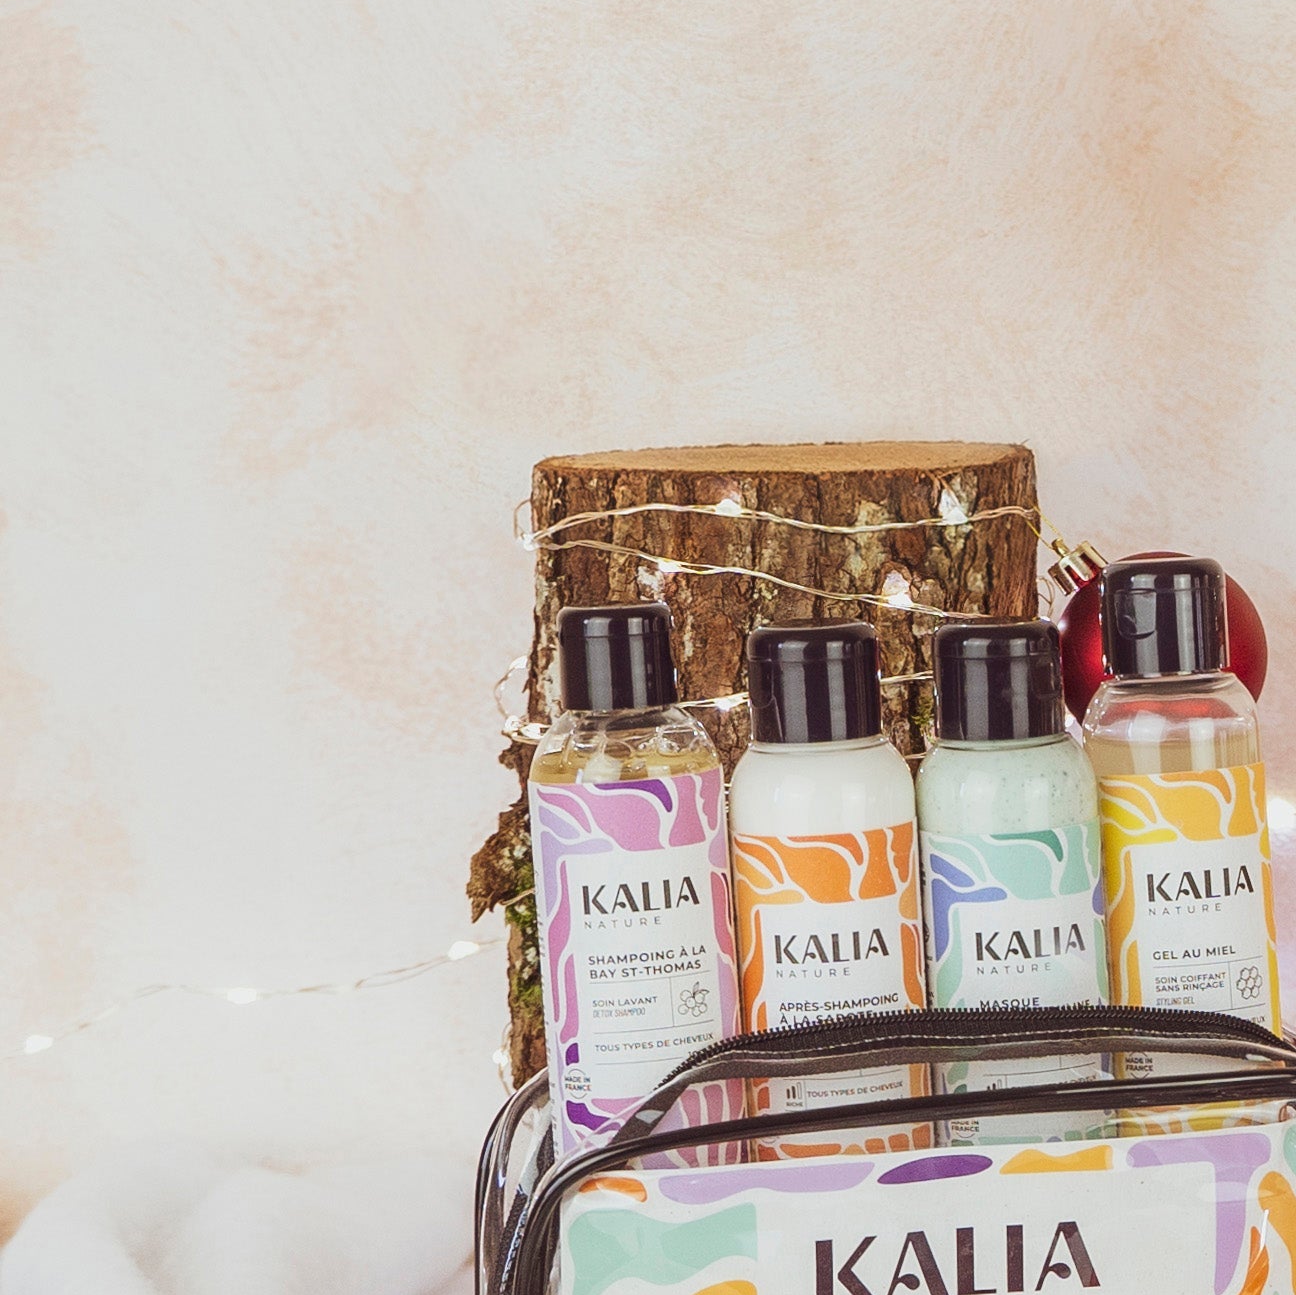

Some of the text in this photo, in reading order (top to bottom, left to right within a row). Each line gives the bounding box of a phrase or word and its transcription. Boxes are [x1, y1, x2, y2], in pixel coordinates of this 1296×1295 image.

[1147, 865, 1254, 902] KALIA
[582, 877, 700, 914] KALIA
[1149, 903, 1222, 915] NATURE
[584, 916, 662, 929] NATURE
[774, 929, 889, 964] KALIA
[975, 923, 1085, 961] KALIA
[588, 945, 706, 965] SHAMPOING À LA
[1153, 946, 1235, 960] GEL AU MIEL
[590, 960, 701, 979] BAY ST-THOMAS
[776, 967, 851, 978] NATURE
[977, 962, 1051, 975] NATURE
[1180, 972, 1226, 983] COIFFANT
[1156, 981, 1224, 992] SANS RINÇAGE
[593, 996, 657, 1007] SOIN LAVANT
[779, 993, 898, 1012] APRÈS-SHAMPOING
[595, 1033, 714, 1052] TOUS TYPES DE CHEVEUX
